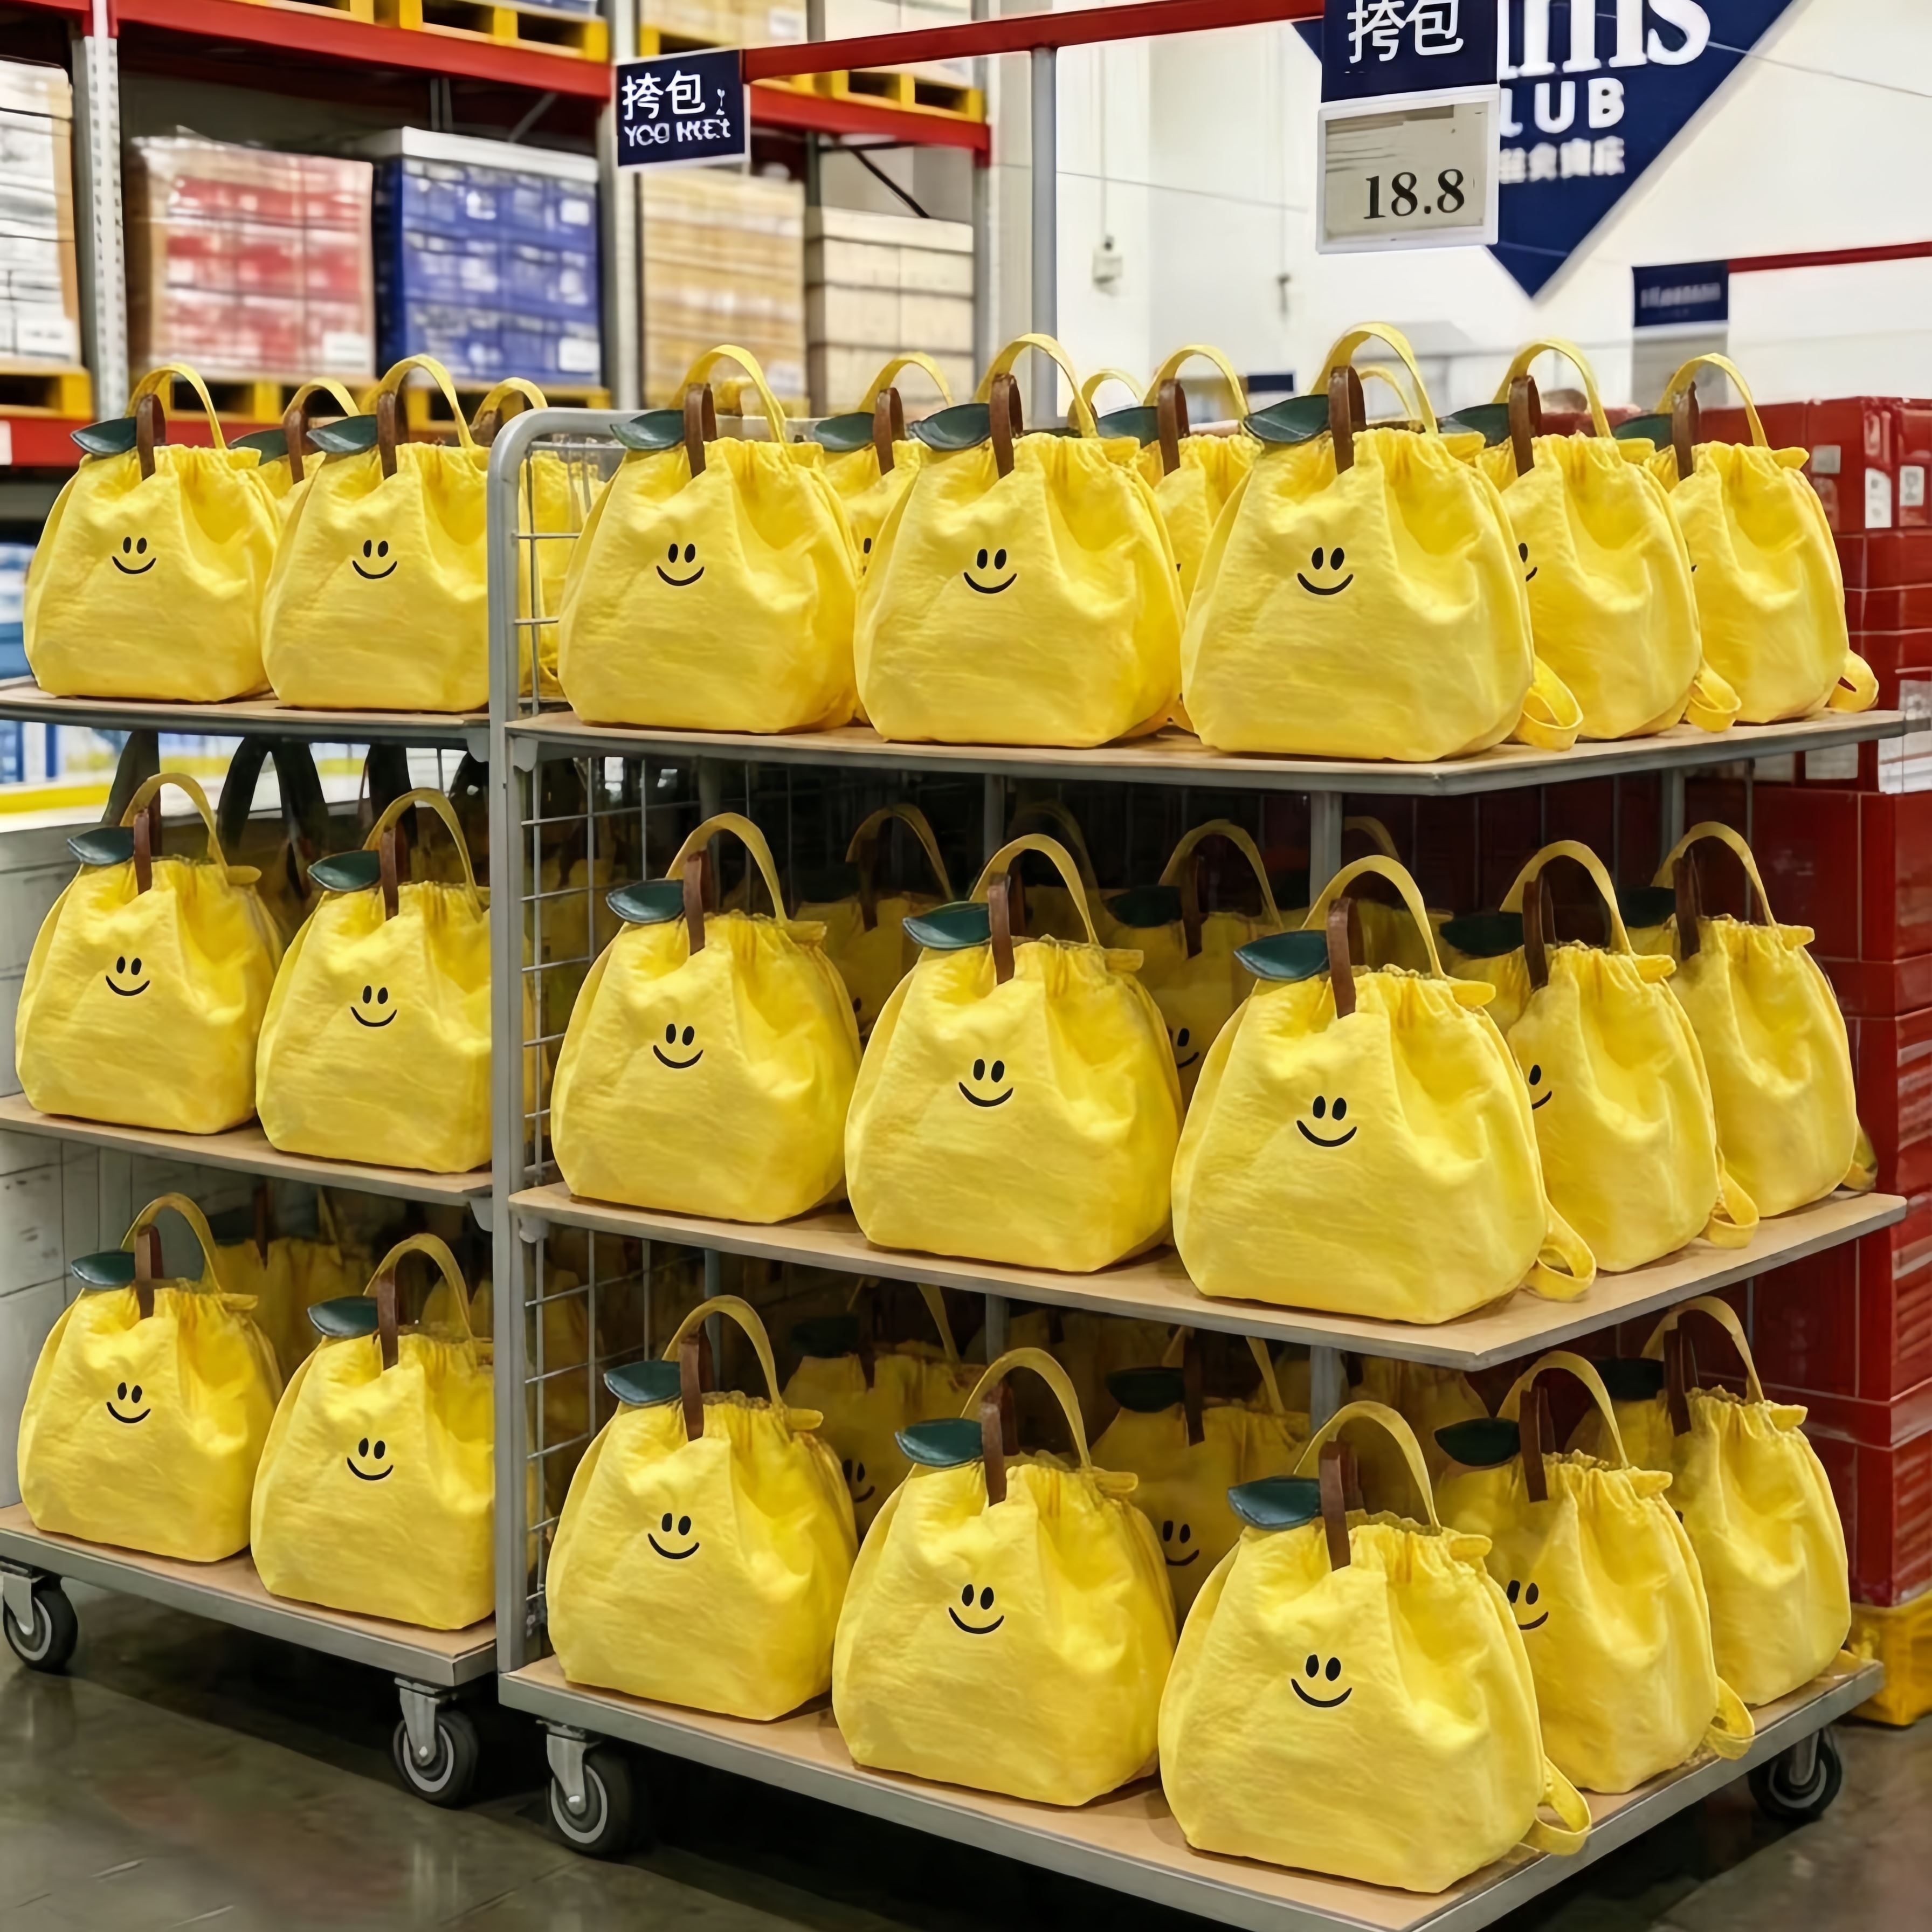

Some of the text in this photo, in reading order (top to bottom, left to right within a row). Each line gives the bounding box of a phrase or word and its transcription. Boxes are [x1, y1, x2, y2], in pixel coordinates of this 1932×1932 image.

[1348, 0, 1464, 64] 挎包
[622, 70, 706, 120] 挎包
[1363, 168, 1465, 219] 18.8
